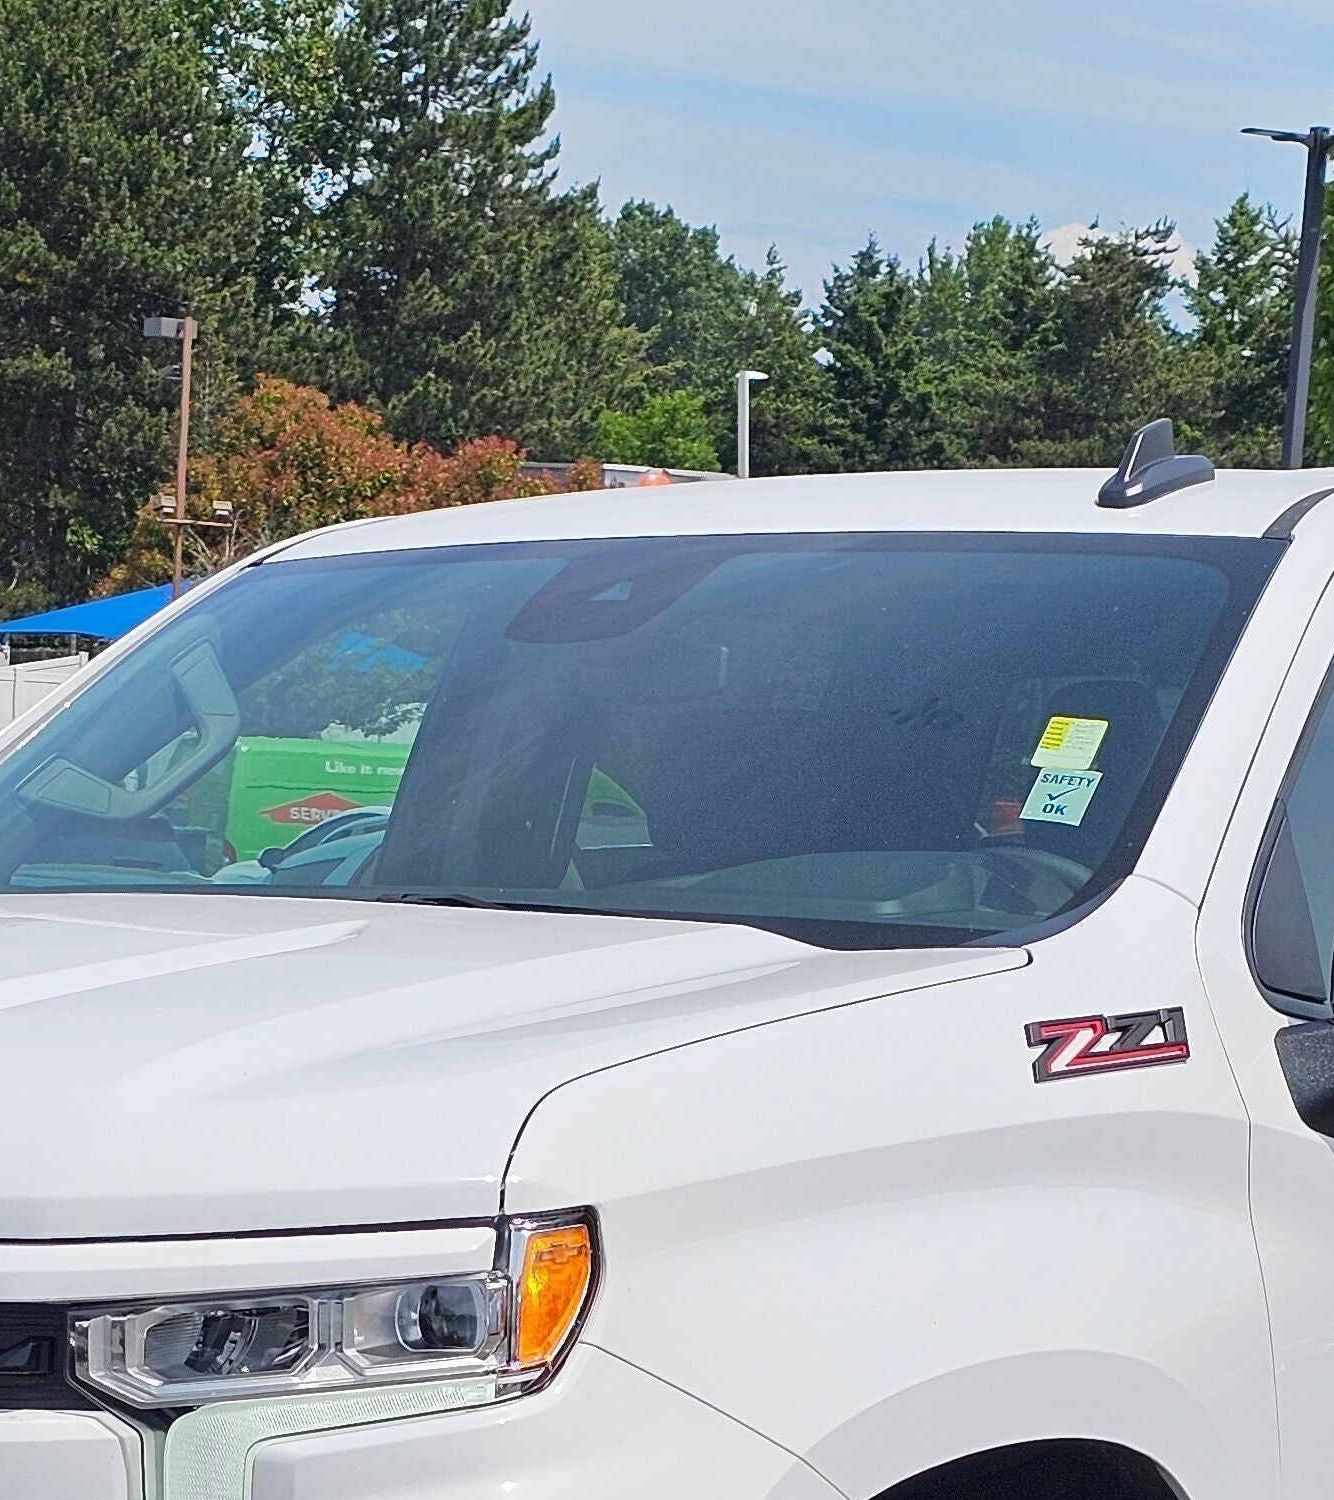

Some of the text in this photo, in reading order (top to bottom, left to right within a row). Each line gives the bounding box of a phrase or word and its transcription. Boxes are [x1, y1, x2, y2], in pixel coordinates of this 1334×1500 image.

[324, 759, 357, 775] Like
[359, 763, 374, 775] it
[1040, 773, 1096, 788] SAFETY
[1042, 803, 1068, 815] OK
[1024, 1006, 1190, 1083] Z71
